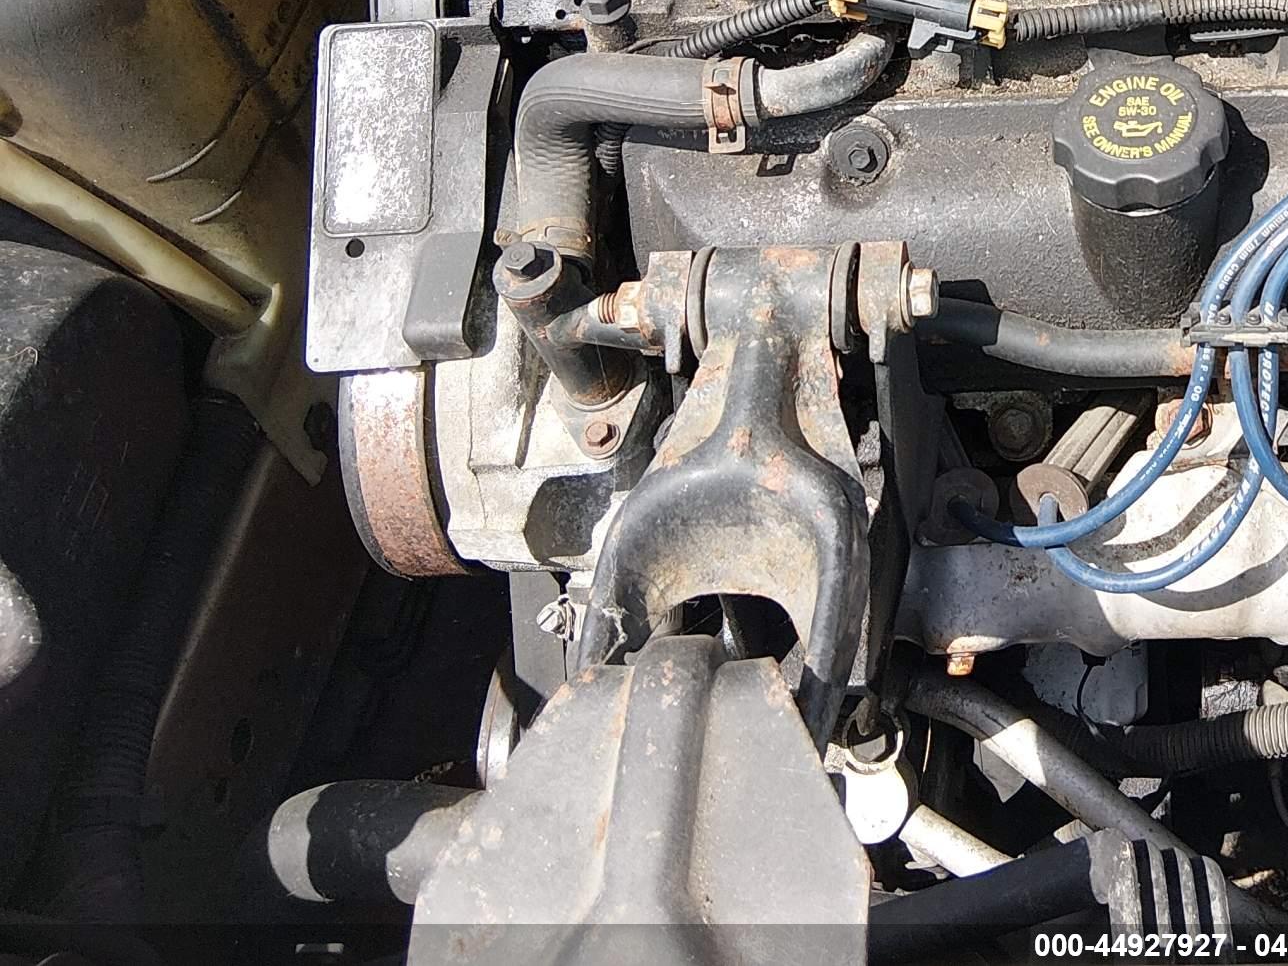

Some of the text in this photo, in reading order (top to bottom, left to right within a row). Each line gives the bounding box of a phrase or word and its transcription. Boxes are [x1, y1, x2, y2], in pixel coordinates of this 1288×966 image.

[1089, 76, 1185, 107] ENGINE OIL
[1126, 96, 1150, 107] SAE
[1118, 105, 1157, 117] 5W-30
[1082, 111, 1193, 159] SEE OWNER'S MANUAL
